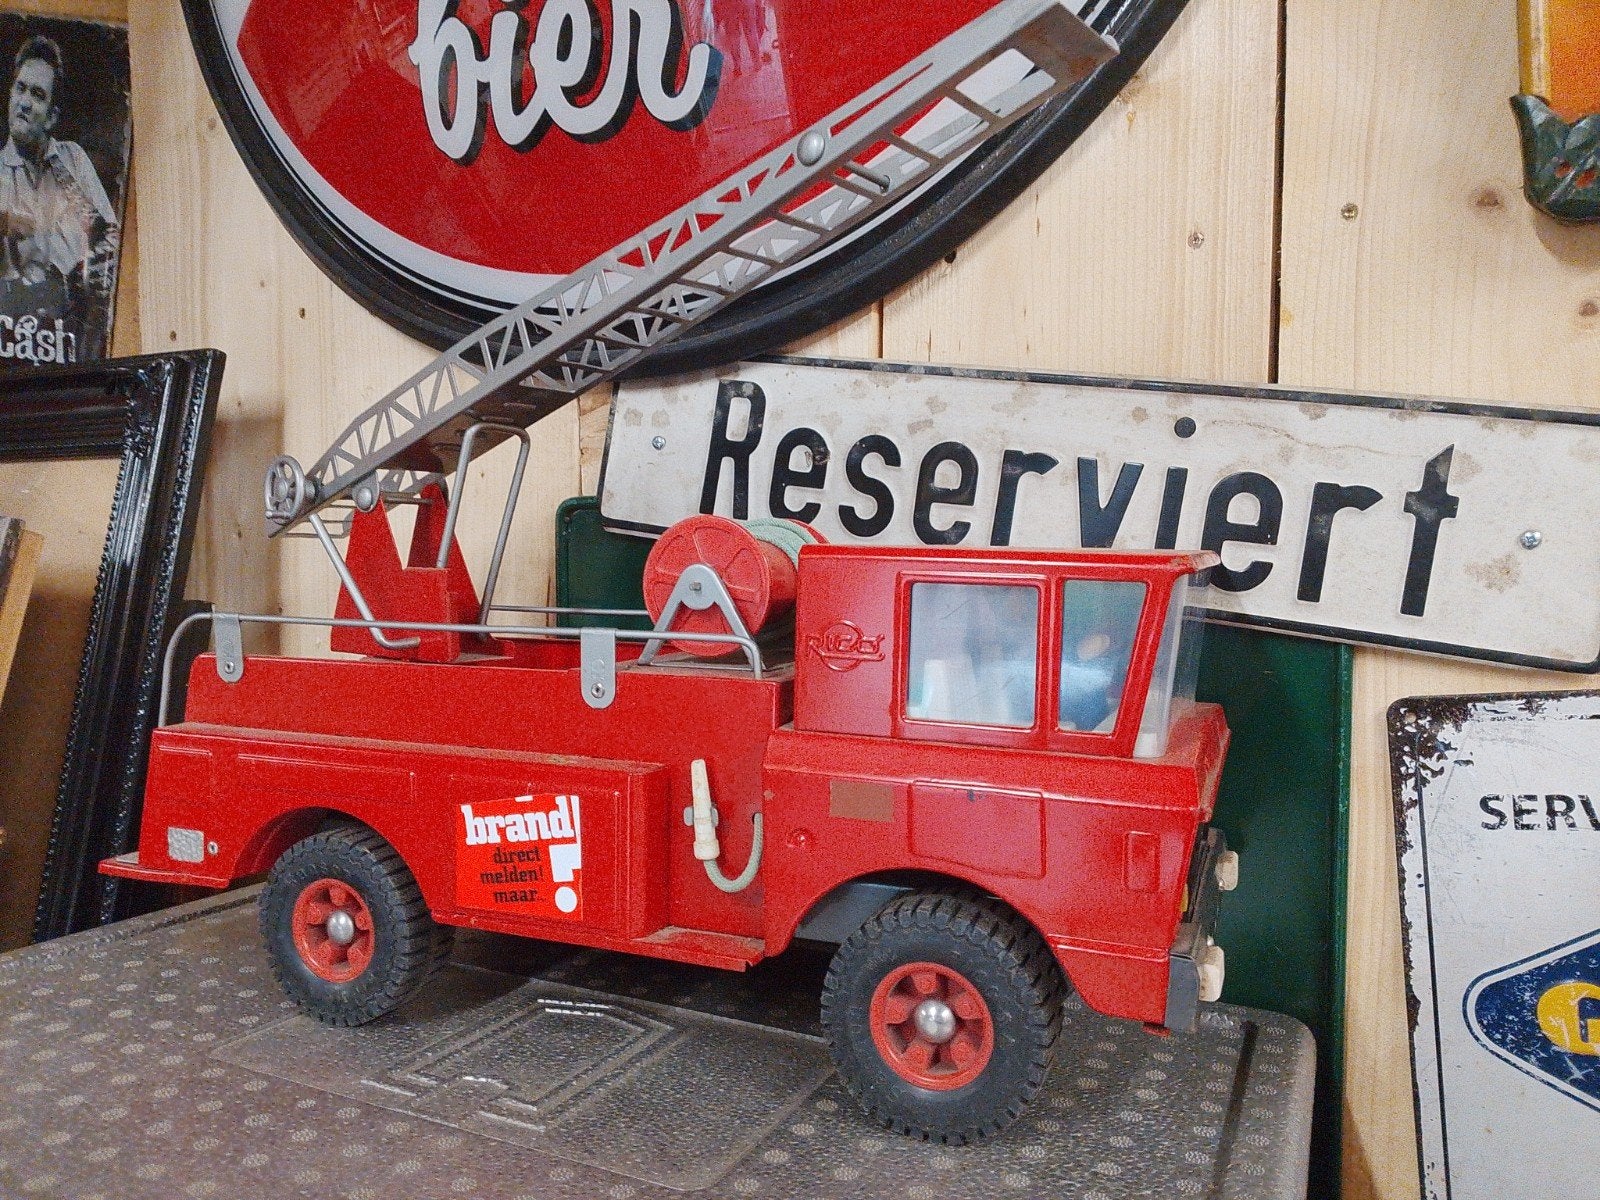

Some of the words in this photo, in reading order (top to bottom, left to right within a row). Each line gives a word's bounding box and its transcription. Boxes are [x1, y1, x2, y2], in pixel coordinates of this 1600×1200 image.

[408, 0, 722, 165] bier
[0, 314, 76, 367] Cash
[699, 379, 1461, 617] Reserviert
[493, 847, 541, 863] direct
